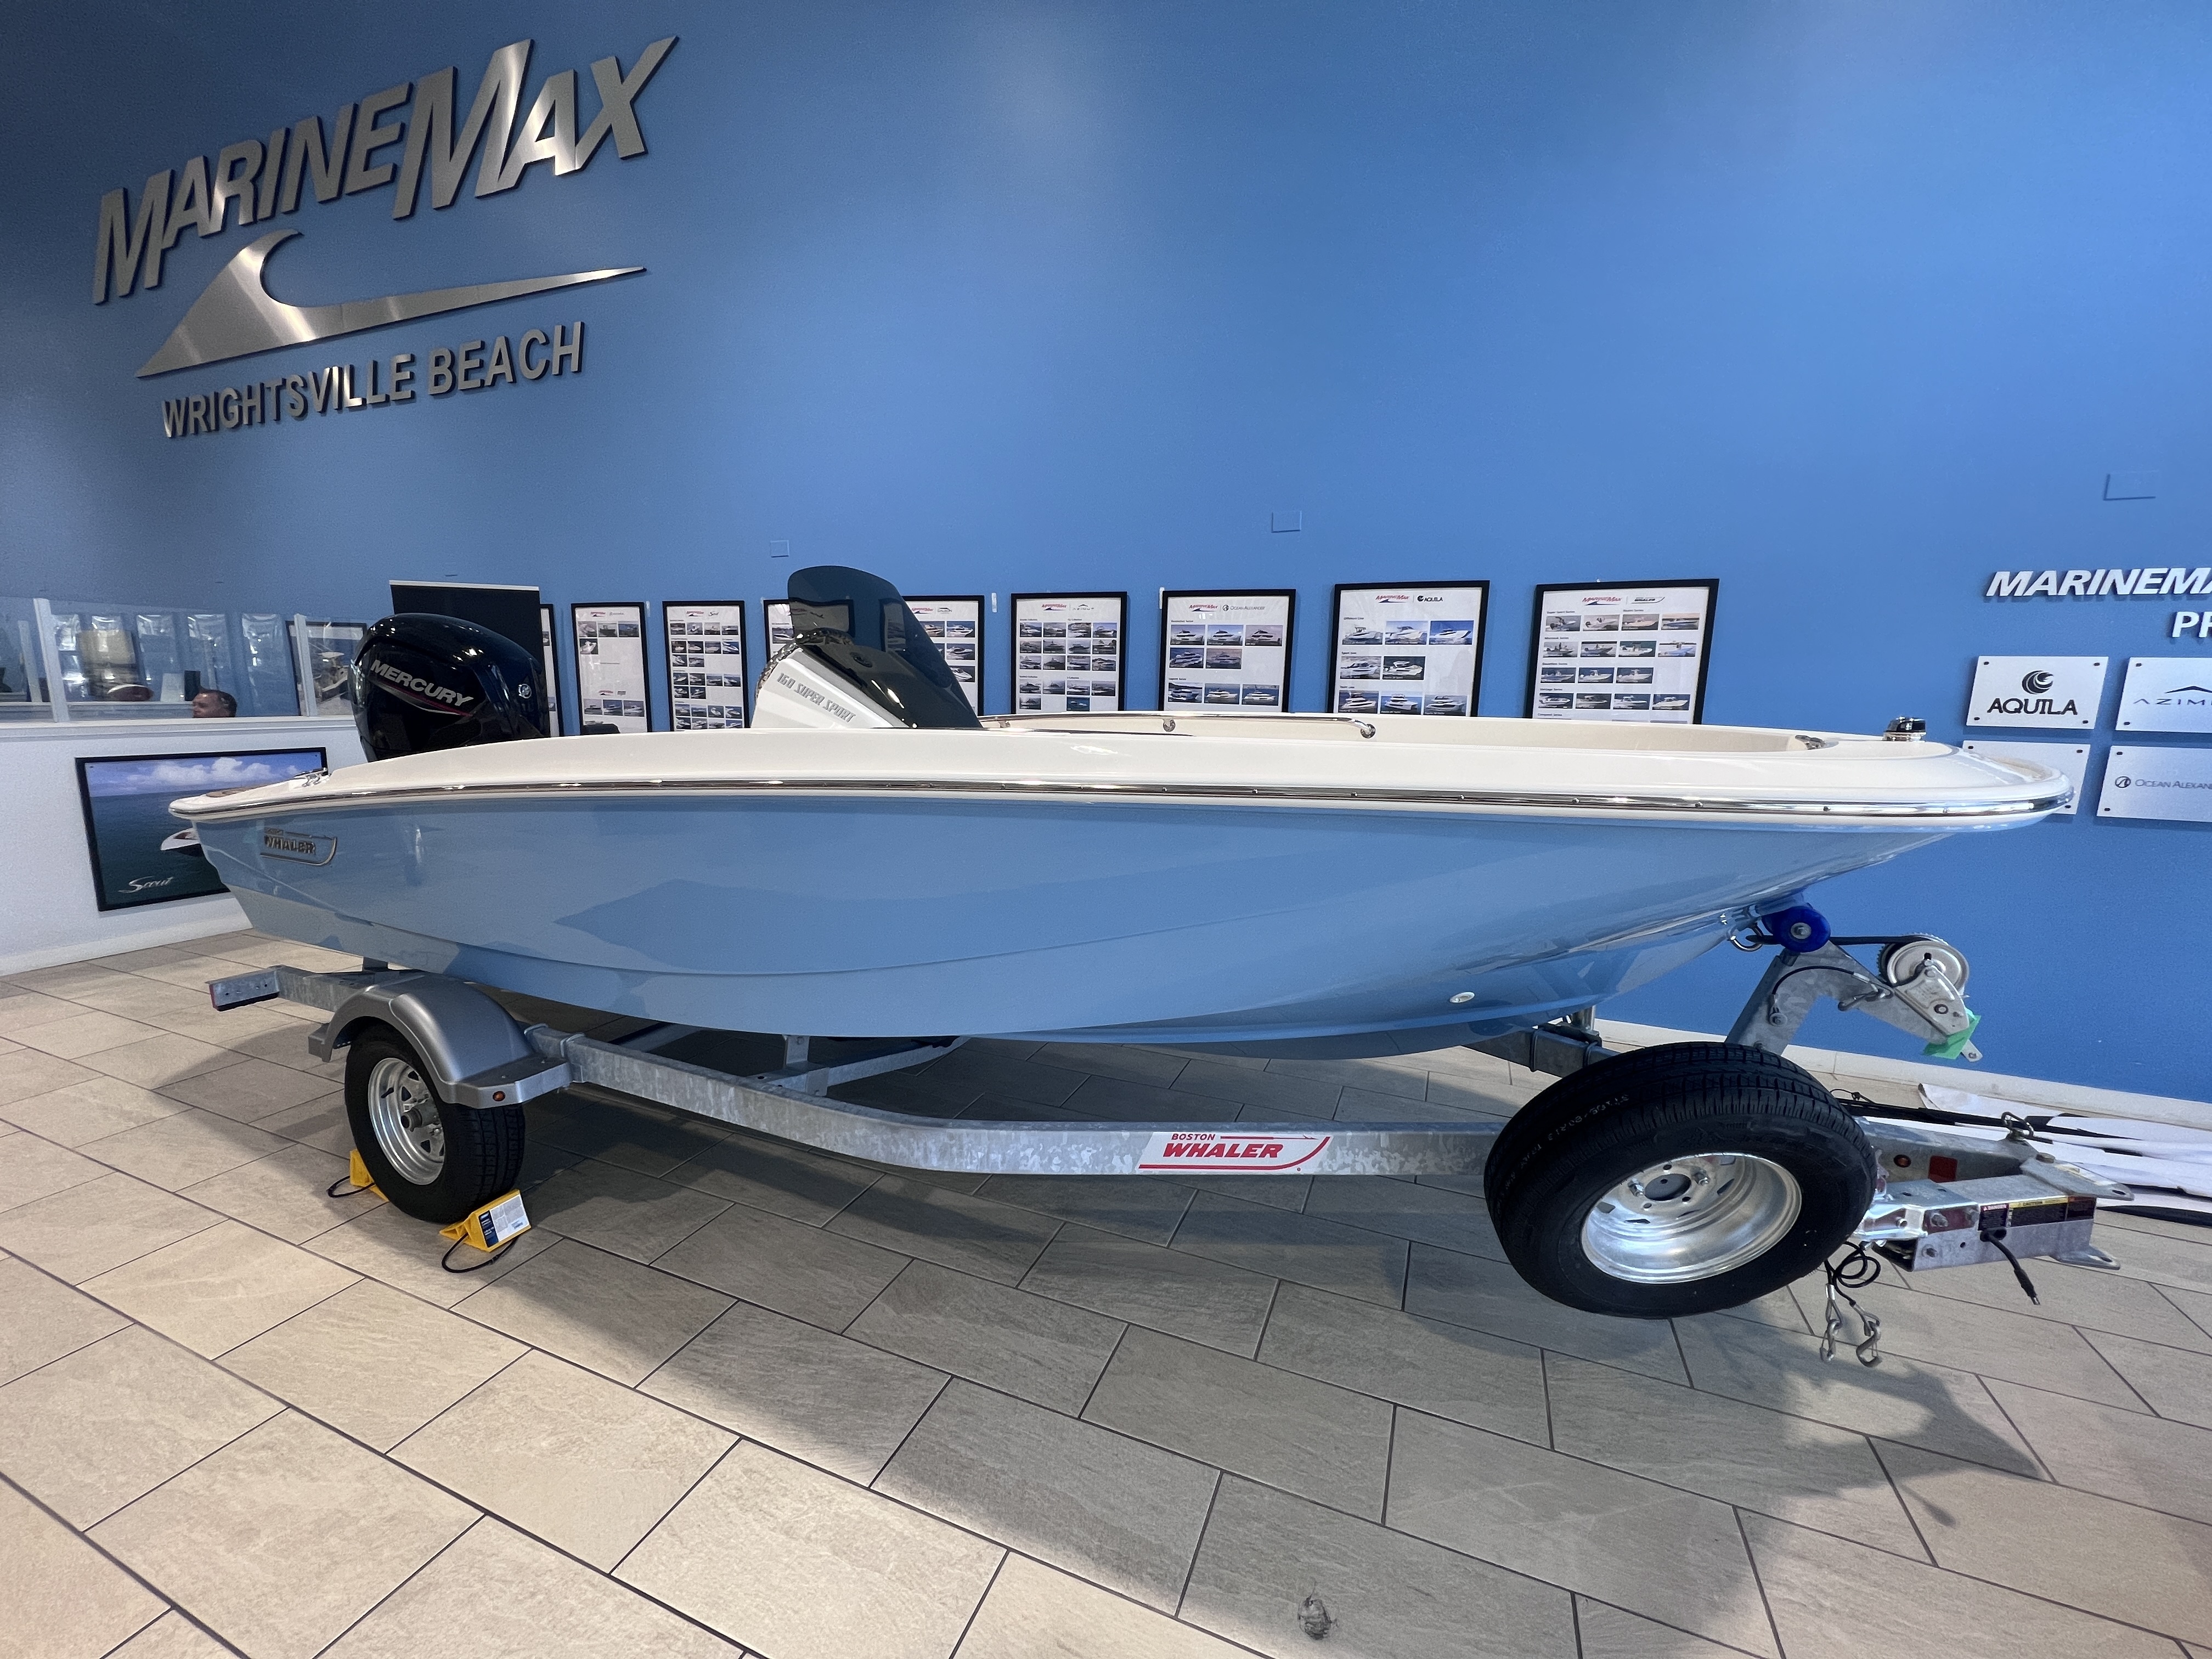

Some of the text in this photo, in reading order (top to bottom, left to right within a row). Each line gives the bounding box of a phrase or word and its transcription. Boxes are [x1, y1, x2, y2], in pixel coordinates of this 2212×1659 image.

[93, 36, 679, 305] MARINEMAX
[161, 321, 584, 438] WRIGHTSVILLE BEACH
[370, 659, 474, 707] MERCURY
[777, 673, 856, 723] 160 SUPER SPORT
[1987, 697, 2078, 715] AQUILA
[2135, 779, 2171, 788] OCEAN
[264, 834, 317, 855] WHALER
[1163, 1143, 1284, 1158] WHALER
